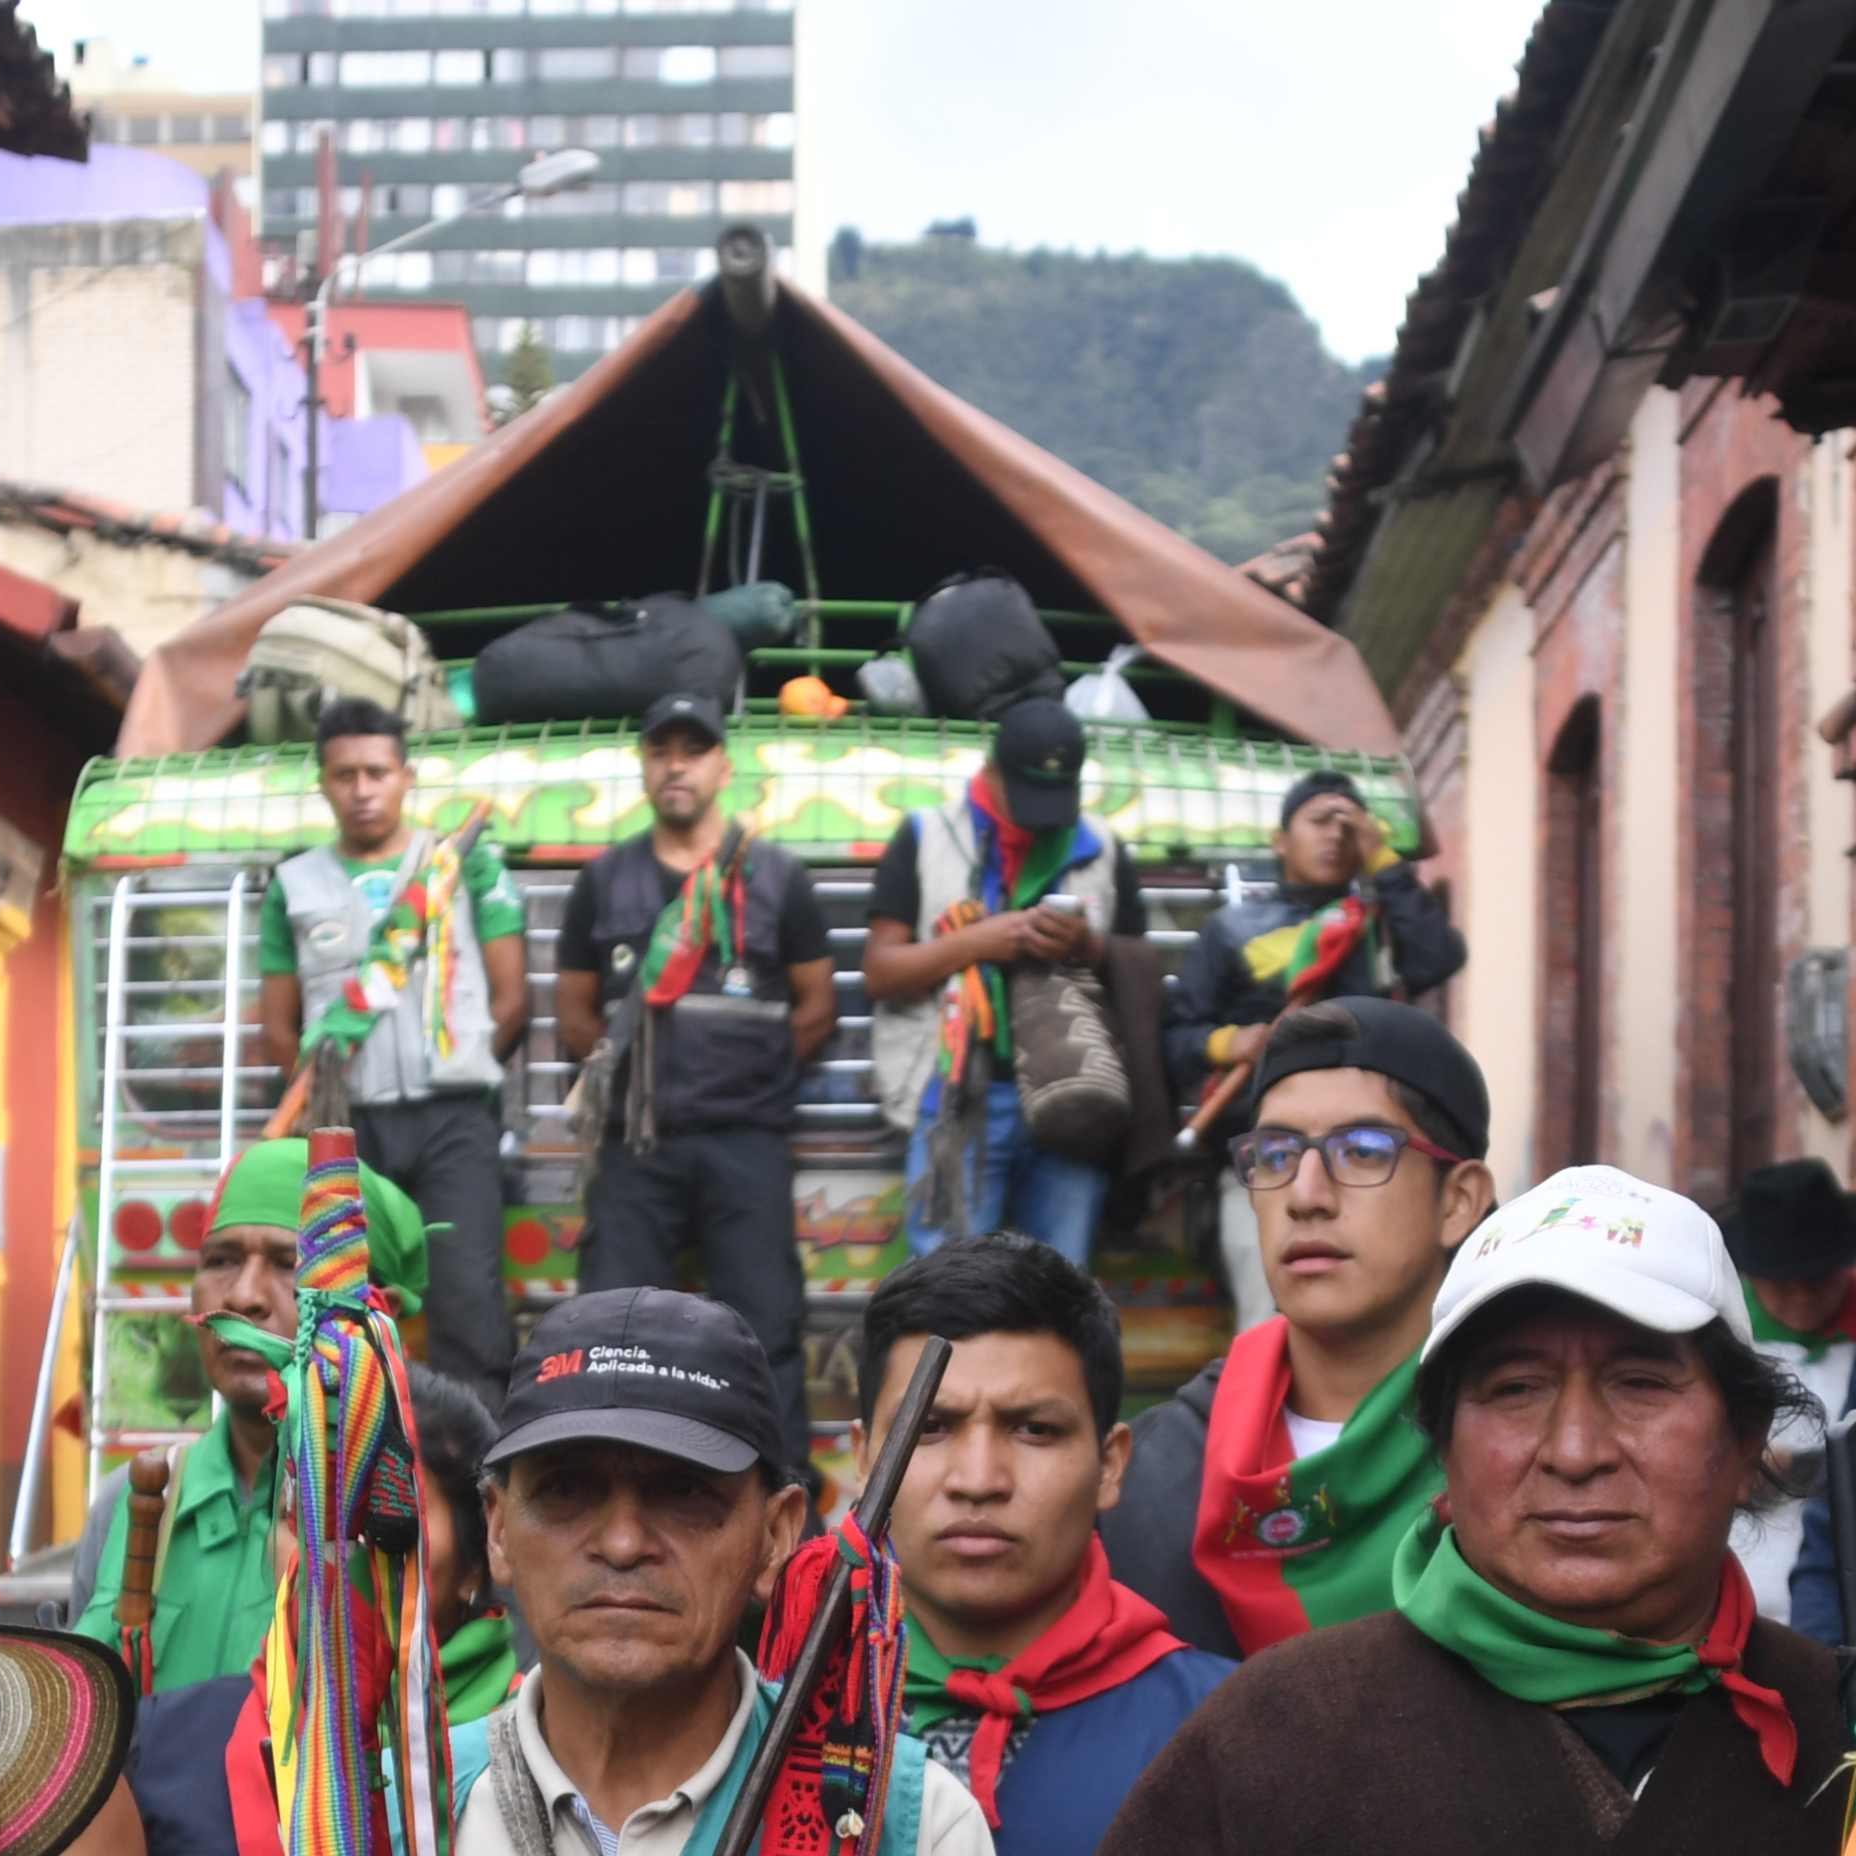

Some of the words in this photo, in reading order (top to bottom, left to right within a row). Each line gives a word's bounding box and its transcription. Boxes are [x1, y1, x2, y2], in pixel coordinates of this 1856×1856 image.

[589, 1346, 651, 1359] Ciencia.
[535, 1348, 584, 1384] 3M
[587, 1359, 655, 1374] Aplicada
[658, 1365, 668, 1376] a
[671, 1365, 685, 1380] la
